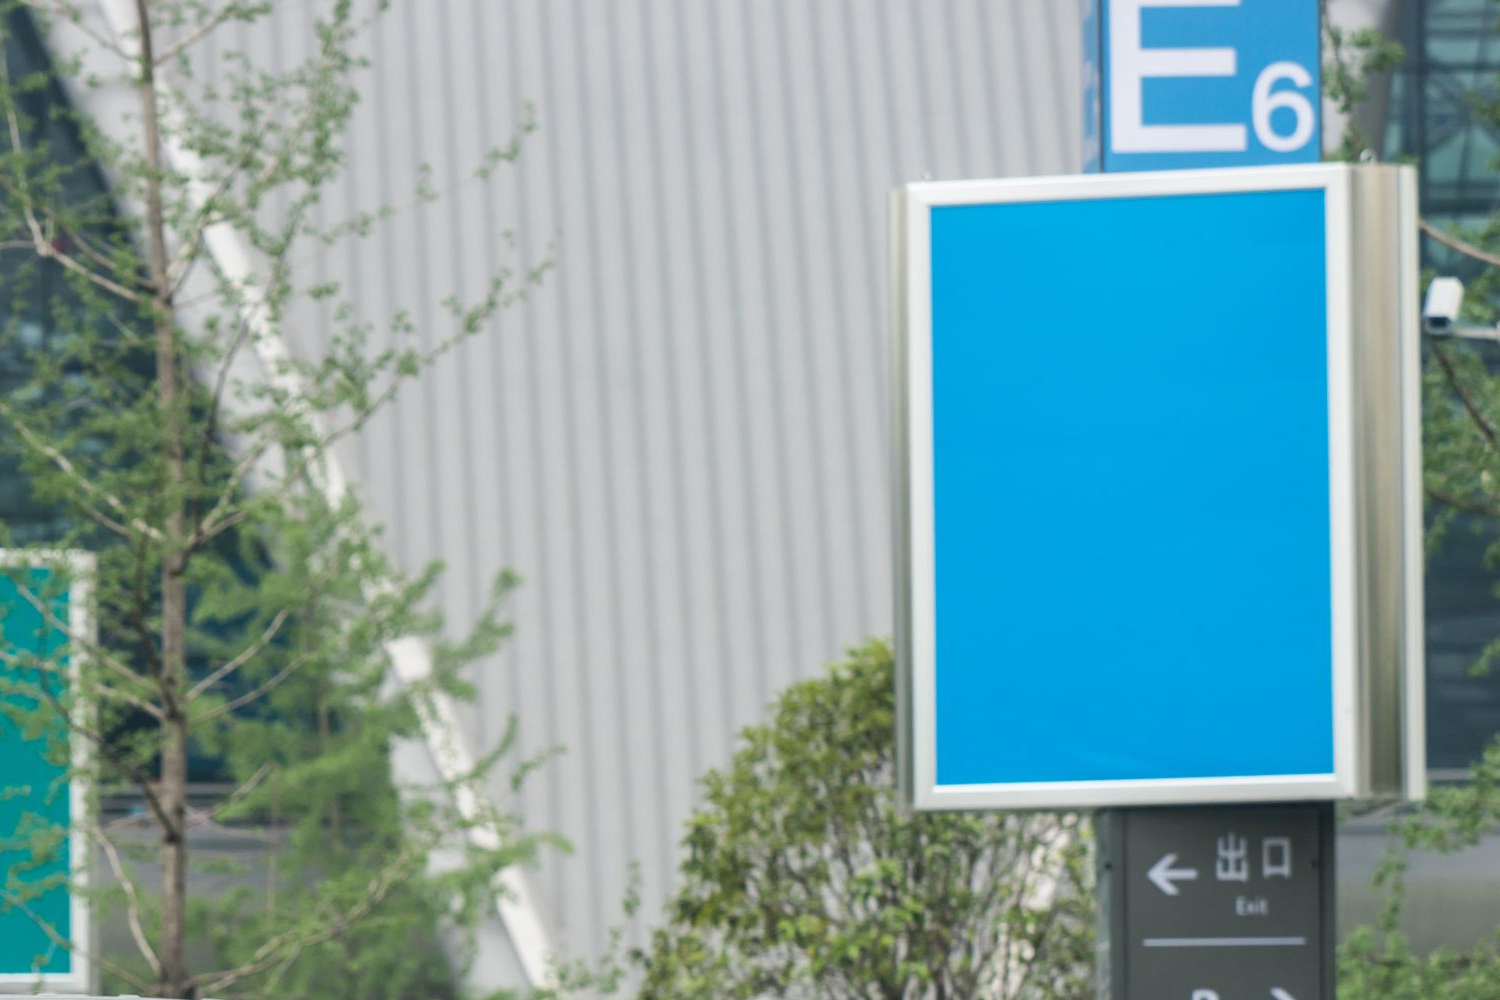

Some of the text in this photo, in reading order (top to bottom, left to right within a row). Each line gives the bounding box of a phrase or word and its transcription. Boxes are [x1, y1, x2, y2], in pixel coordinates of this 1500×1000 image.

[1109, 0, 1315, 153] E6
[1216, 833, 1291, 882] 出口
[1235, 897, 1269, 916] Exit
